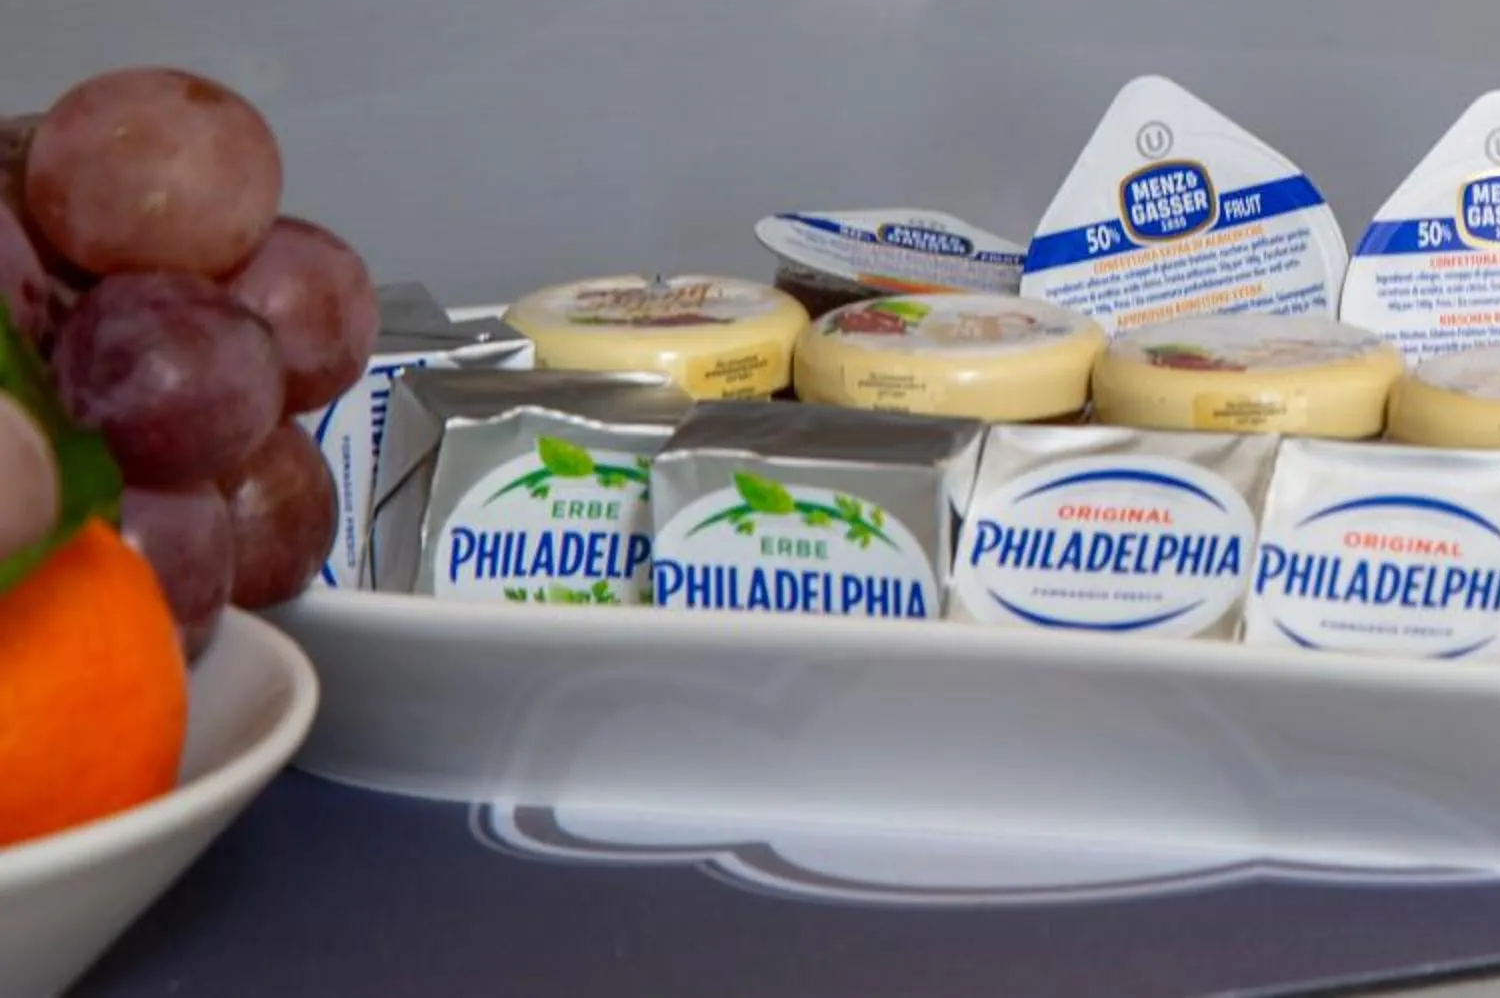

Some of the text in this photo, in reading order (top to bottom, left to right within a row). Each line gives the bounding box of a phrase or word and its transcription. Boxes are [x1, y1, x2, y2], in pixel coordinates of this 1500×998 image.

[1131, 191, 1208, 226] GASSER
[1224, 194, 1262, 220] FRUIT
[551, 500, 620, 520] ERBE
[1057, 505, 1174, 524] ORIGINAL
[450, 527, 653, 582] PHILADELP
[760, 536, 829, 560] ERBE
[970, 519, 1242, 577] PHILADELPHIA
[1344, 531, 1463, 558] ORIGINAL
[653, 559, 926, 618] PHILADELPHIA
